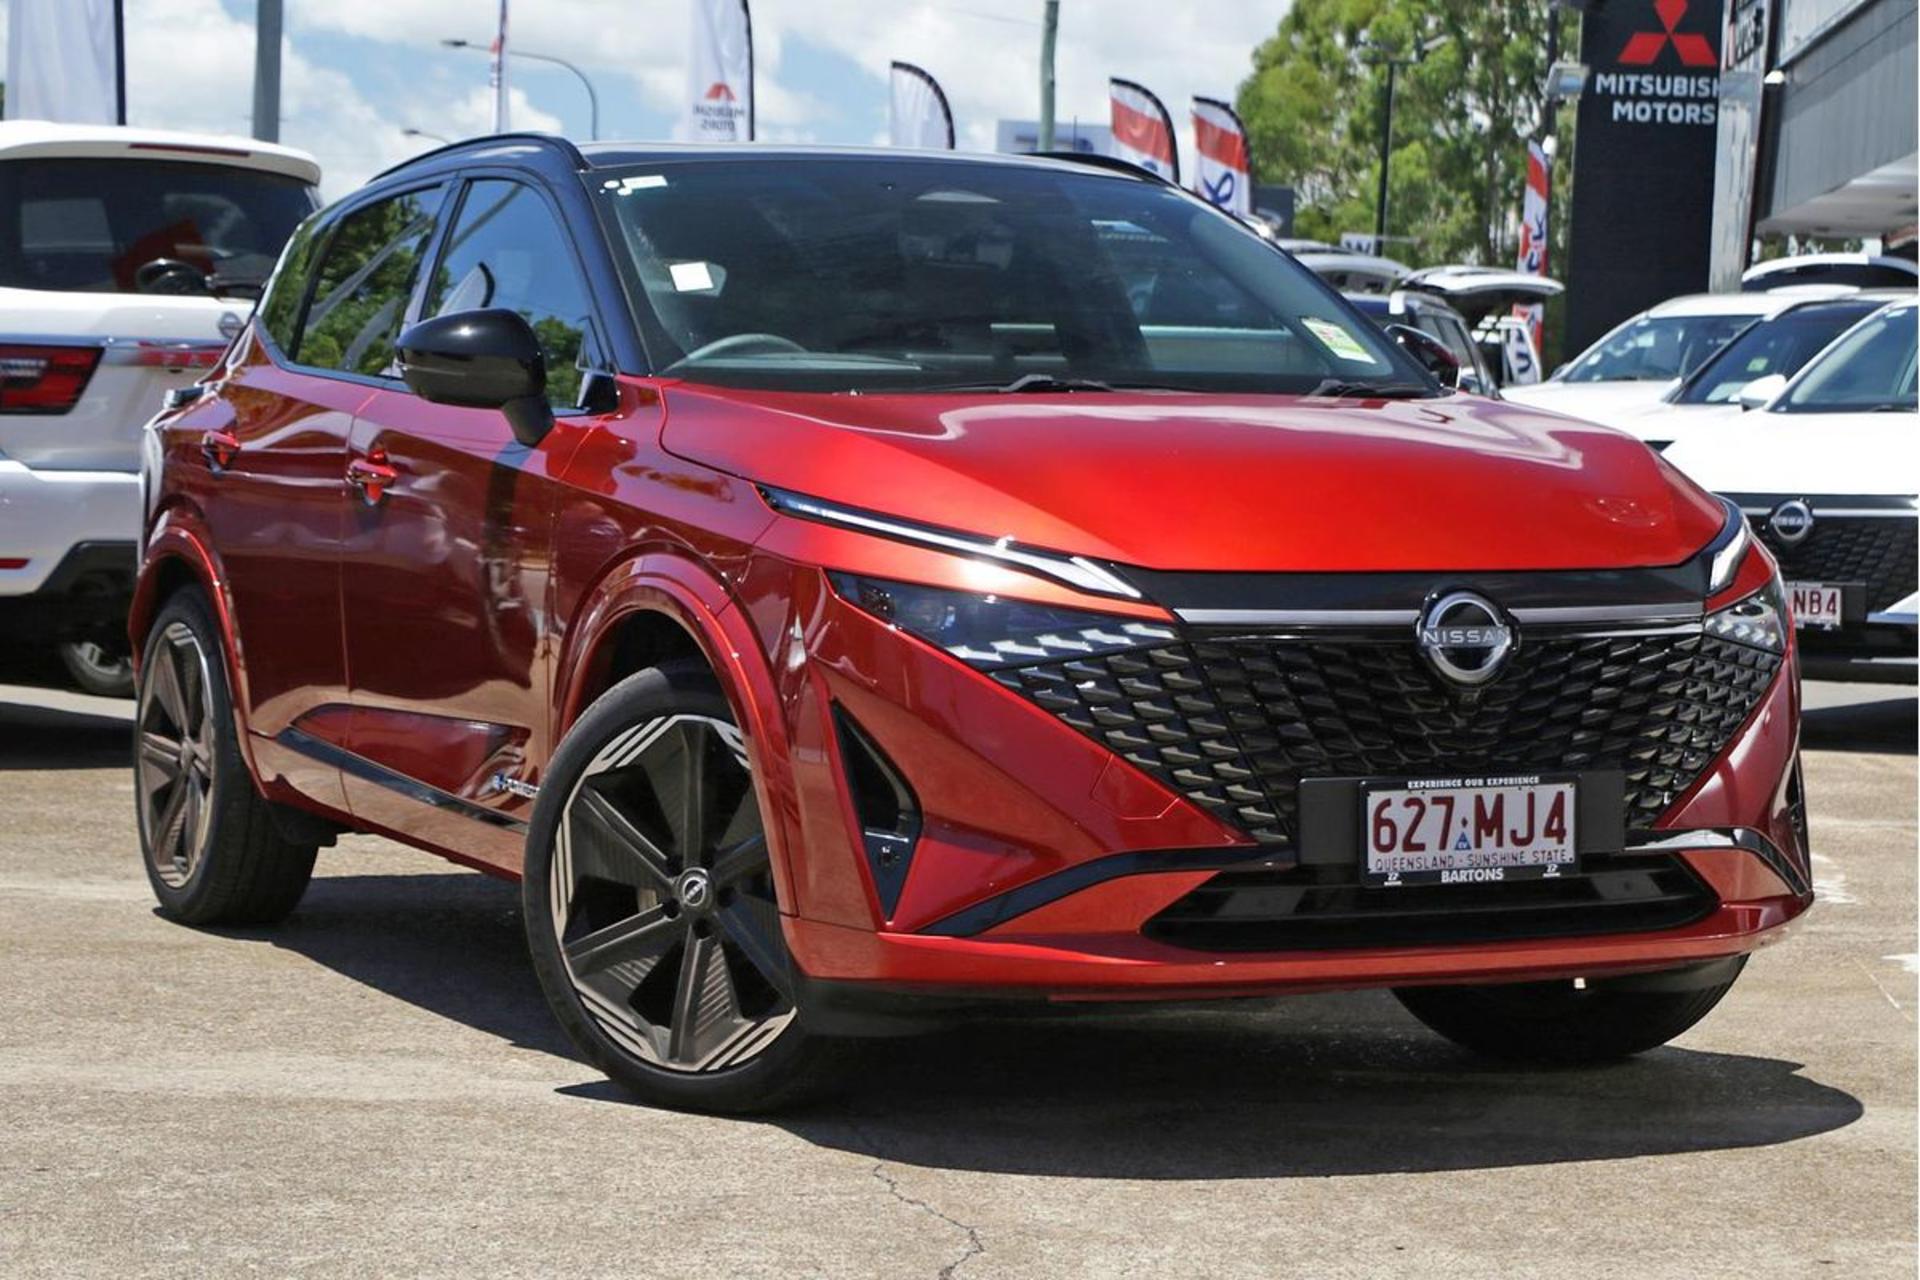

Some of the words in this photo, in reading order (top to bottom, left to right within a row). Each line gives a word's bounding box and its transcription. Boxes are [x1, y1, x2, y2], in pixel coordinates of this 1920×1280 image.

[1612, 101, 1716, 124] MOTORS
[1793, 590, 1837, 616] NB4
[1422, 629, 1508, 644] NISSAN
[1407, 780, 1462, 789] EXPERIENCE
[1464, 778, 1484, 787] OUR
[1486, 776, 1540, 786] EXPERIENCE
[1375, 855, 1455, 872] QUEENSLAND
[1467, 851, 1526, 868] SUNSHINE
[1532, 848, 1567, 864] STATE
[1440, 868, 1505, 884] BARTONS
